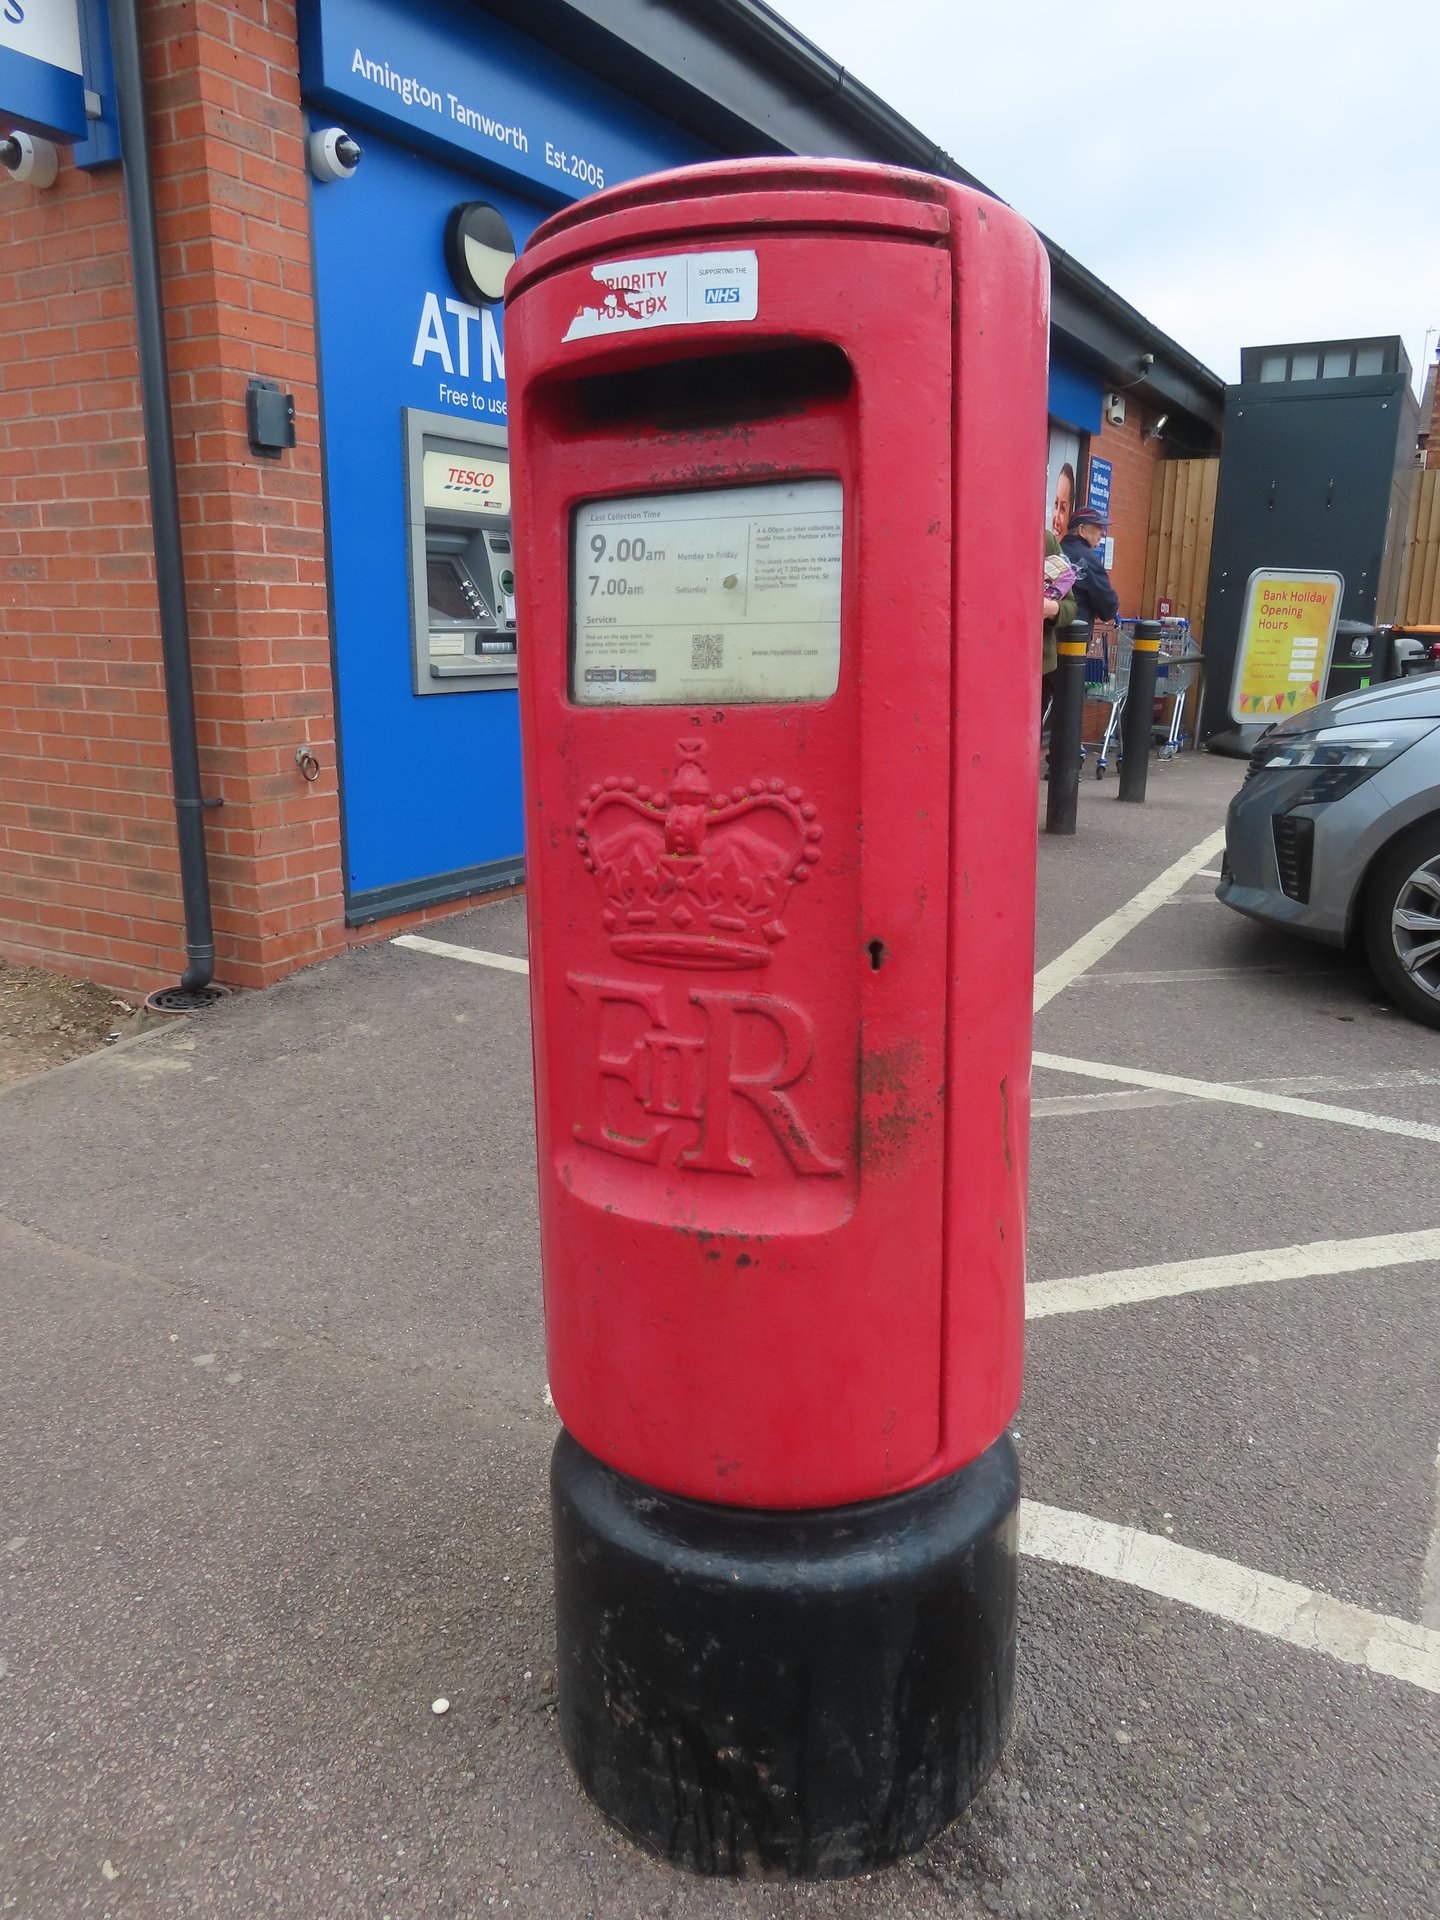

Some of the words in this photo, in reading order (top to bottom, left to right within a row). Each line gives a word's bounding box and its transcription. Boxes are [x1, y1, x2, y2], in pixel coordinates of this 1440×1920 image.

[351, 48, 443, 113] Amington
[447, 93, 529, 153] Tamworth
[545, 142, 605, 190] Est.2005
[698, 268, 734, 276] SUPPORTING
[601, 271, 667, 291] RIORITY
[705, 288, 740, 304] NHS
[439, 383, 468, 408] Free
[471, 391, 484, 410] to
[488, 398, 507, 416] use
[448, 468, 494, 488] TESCO
[590, 514, 606, 522] Last
[608, 512, 642, 521] Collection
[590, 534, 666, 564] 9.00am
[677, 552, 704, 562] Monday
[716, 551, 739, 560] Friday
[588, 575, 644, 596] 7.00am
[676, 586, 707, 596] Saturday
[1263, 590, 1288, 601] Bank
[1290, 592, 1328, 605] Holiday
[1260, 604, 1304, 618] Opening
[586, 616, 617, 624] Services
[1258, 618, 1288, 630] Hours
